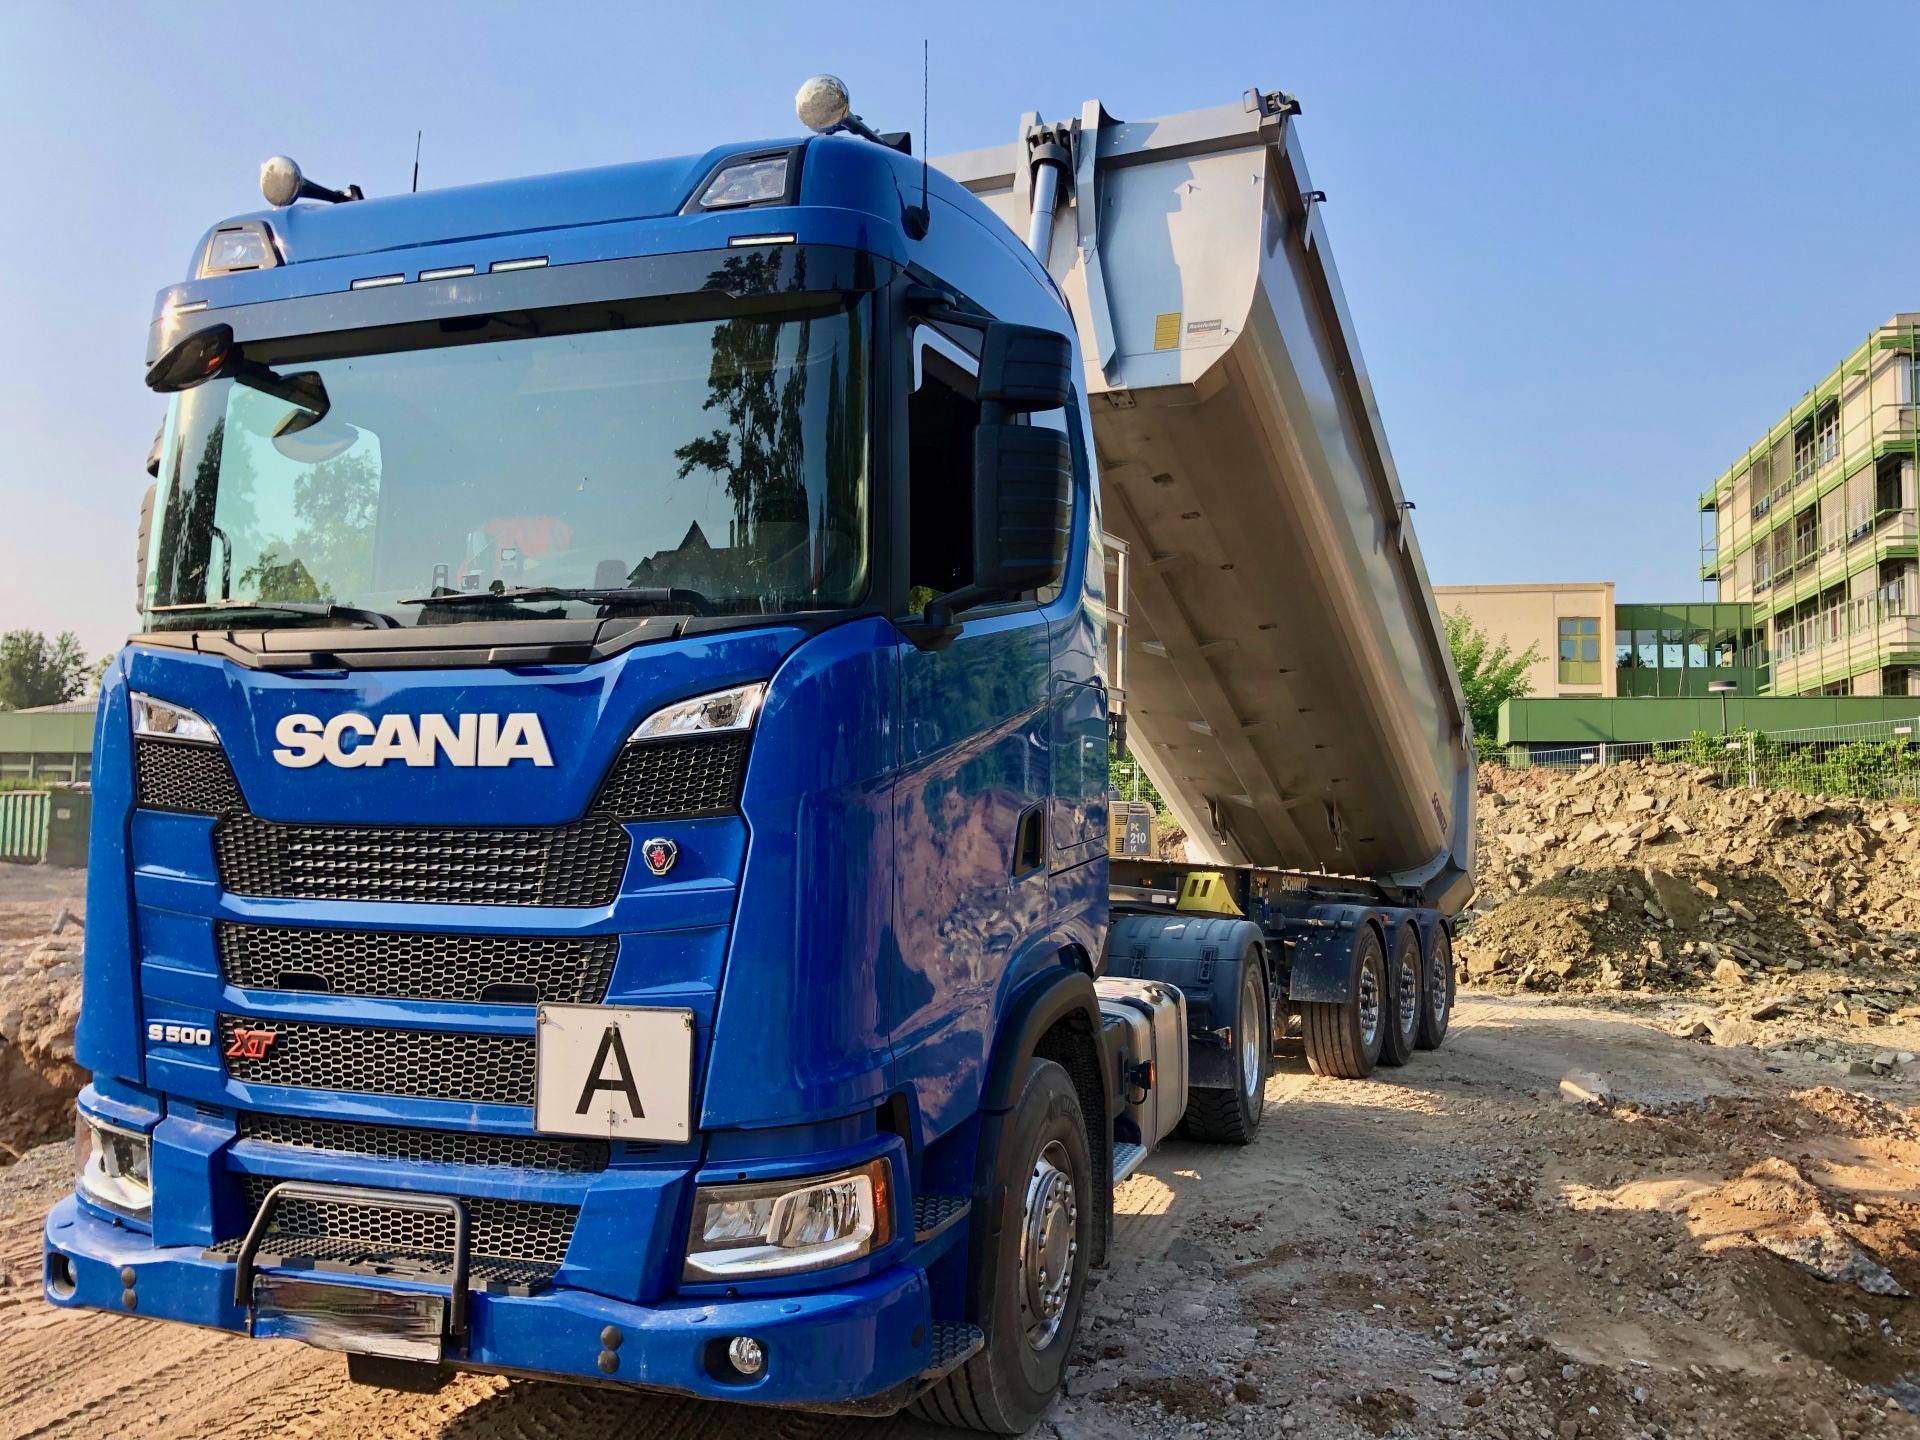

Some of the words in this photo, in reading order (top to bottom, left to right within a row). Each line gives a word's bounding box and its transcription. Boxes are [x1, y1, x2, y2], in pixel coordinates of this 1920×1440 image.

[273, 713, 554, 768] SCANIA
[1130, 832, 1146, 844] 210
[226, 1029, 277, 1058] XT
[575, 1026, 646, 1119] A
